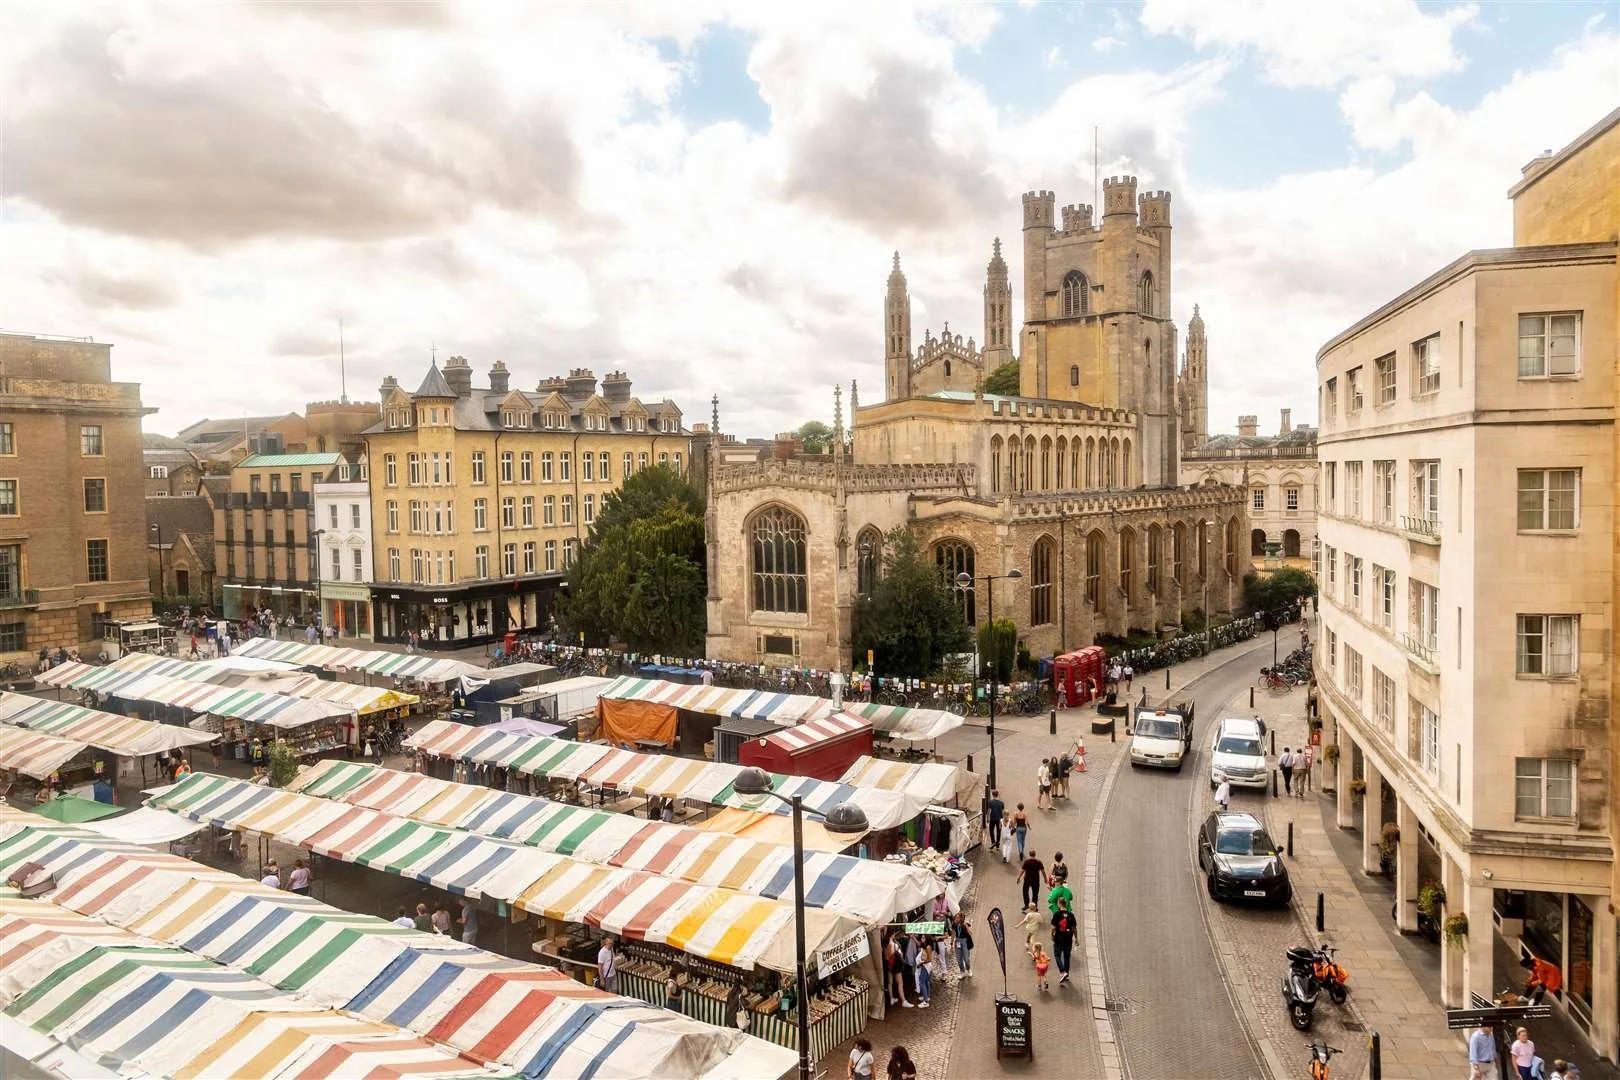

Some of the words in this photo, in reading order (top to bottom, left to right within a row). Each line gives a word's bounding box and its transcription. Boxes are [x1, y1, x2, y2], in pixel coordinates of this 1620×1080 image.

[822, 943, 844, 962] COFFEE
[832, 953, 858, 971] OLIVES
[1002, 1006, 1025, 1014] OLIVES
[1003, 1026, 1025, 1035] SNACKS
